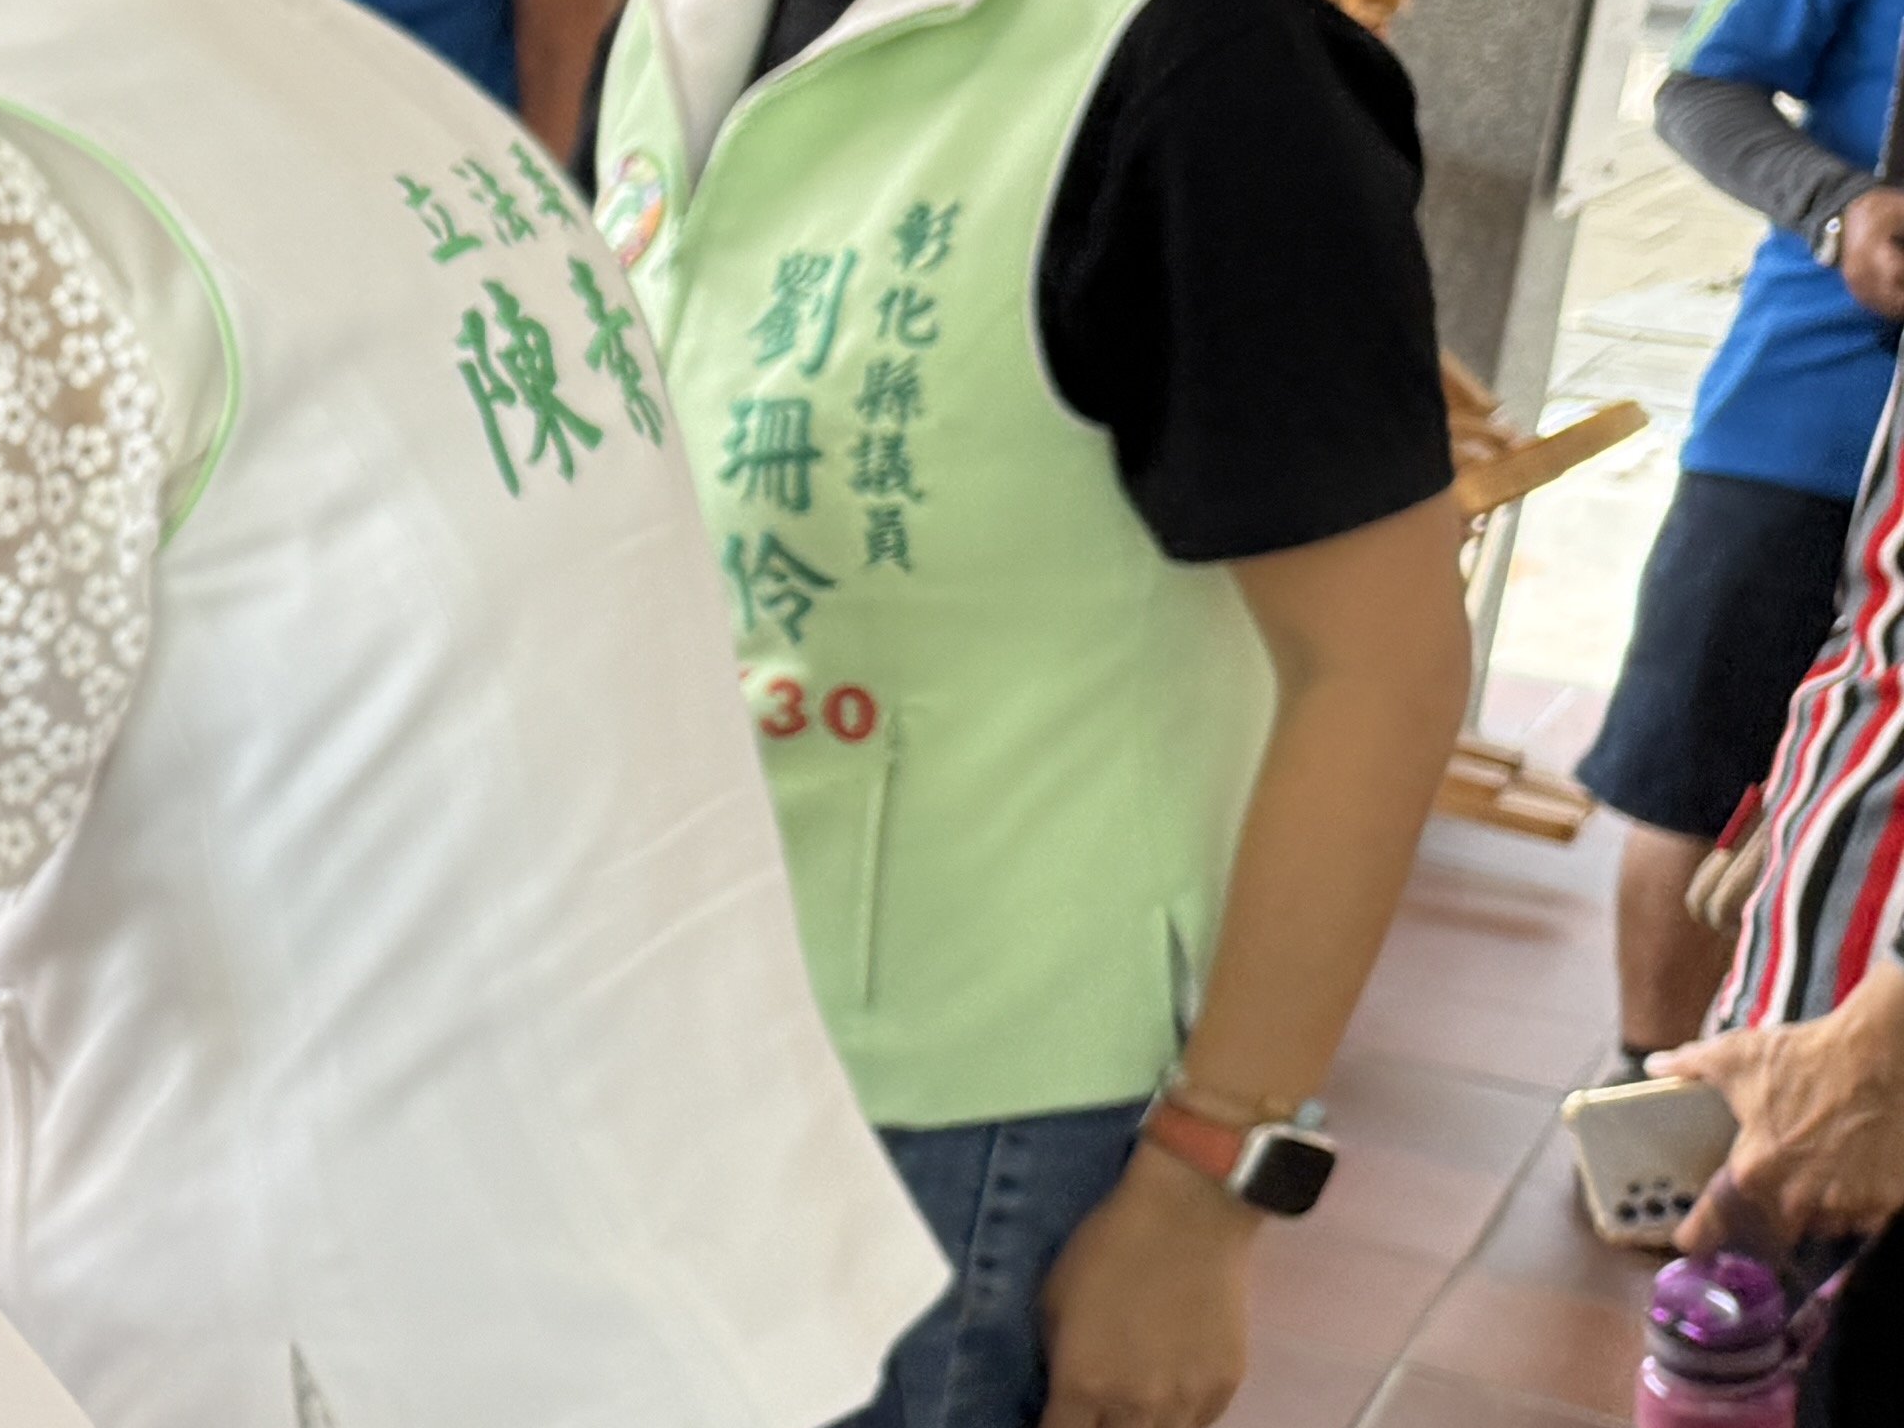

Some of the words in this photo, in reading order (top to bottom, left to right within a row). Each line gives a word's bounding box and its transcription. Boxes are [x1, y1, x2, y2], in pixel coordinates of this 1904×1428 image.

[718, 245, 860, 645] 劉珊伶
[848, 200, 962, 575] 彰化縣議員
[740, 666, 880, 744] 30
